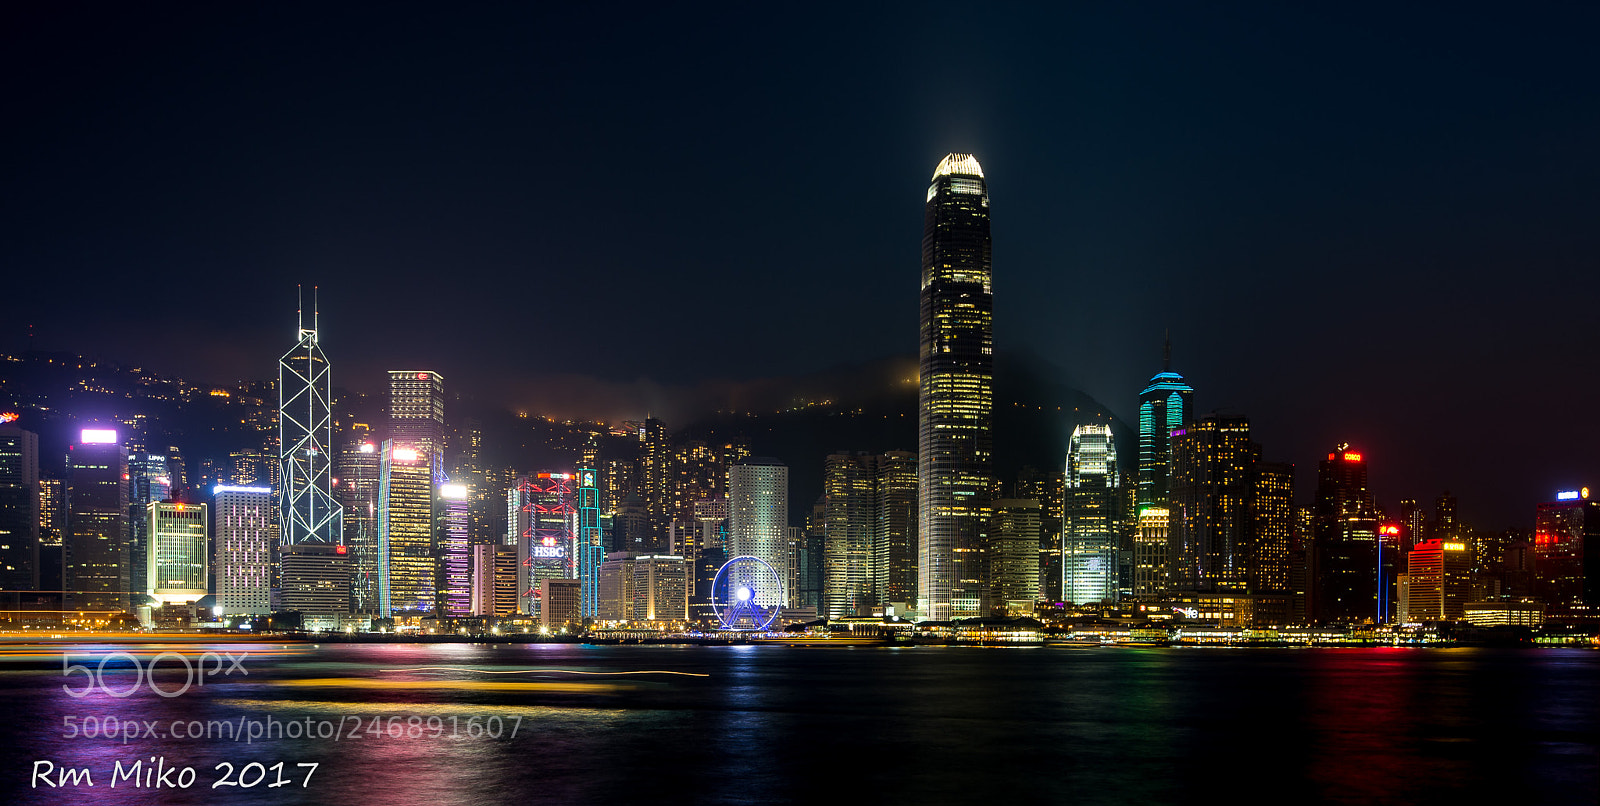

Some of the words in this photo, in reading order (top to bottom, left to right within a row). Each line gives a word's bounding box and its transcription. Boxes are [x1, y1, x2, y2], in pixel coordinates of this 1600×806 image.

[148, 454, 165, 462] LIPPO
[1344, 453, 1361, 462] COSCO
[534, 546, 565, 558] HSBC
